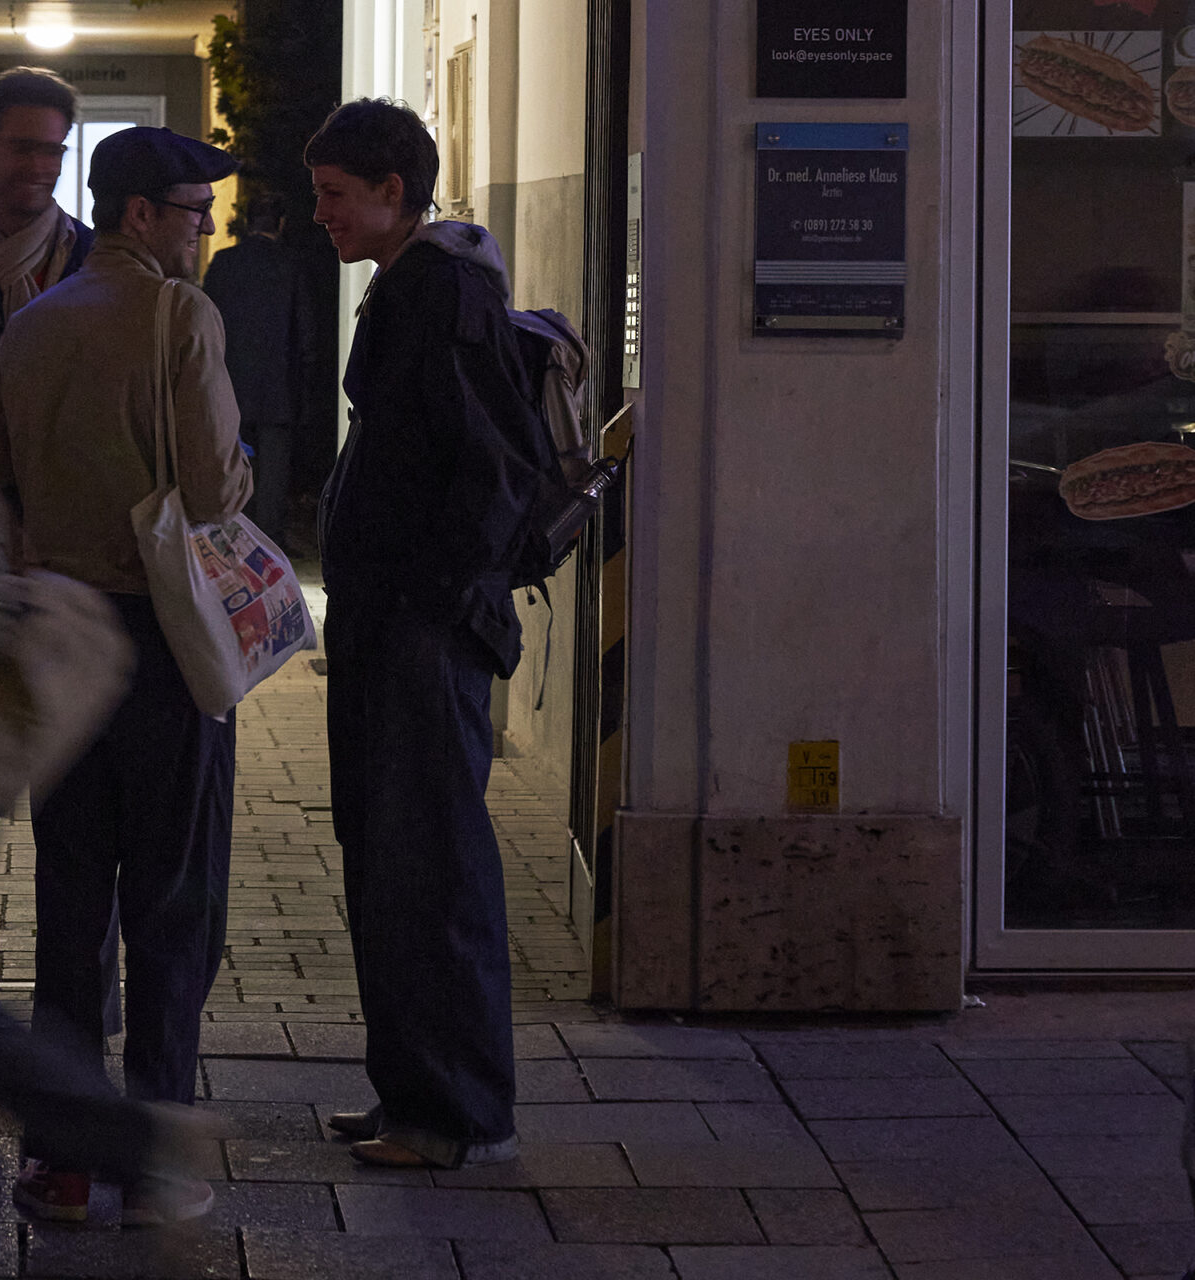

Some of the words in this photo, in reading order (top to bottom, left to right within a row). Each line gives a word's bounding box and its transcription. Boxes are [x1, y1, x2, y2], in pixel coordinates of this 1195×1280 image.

[794, 28, 830, 41] EYES
[835, 28, 874, 42] ONLY
[772, 49, 893, 63] look@eyesonly.space
[768, 168, 782, 182] Dr.
[786, 167, 812, 182] med.
[815, 167, 866, 182] Anneliese
[869, 168, 898, 183] Klaus
